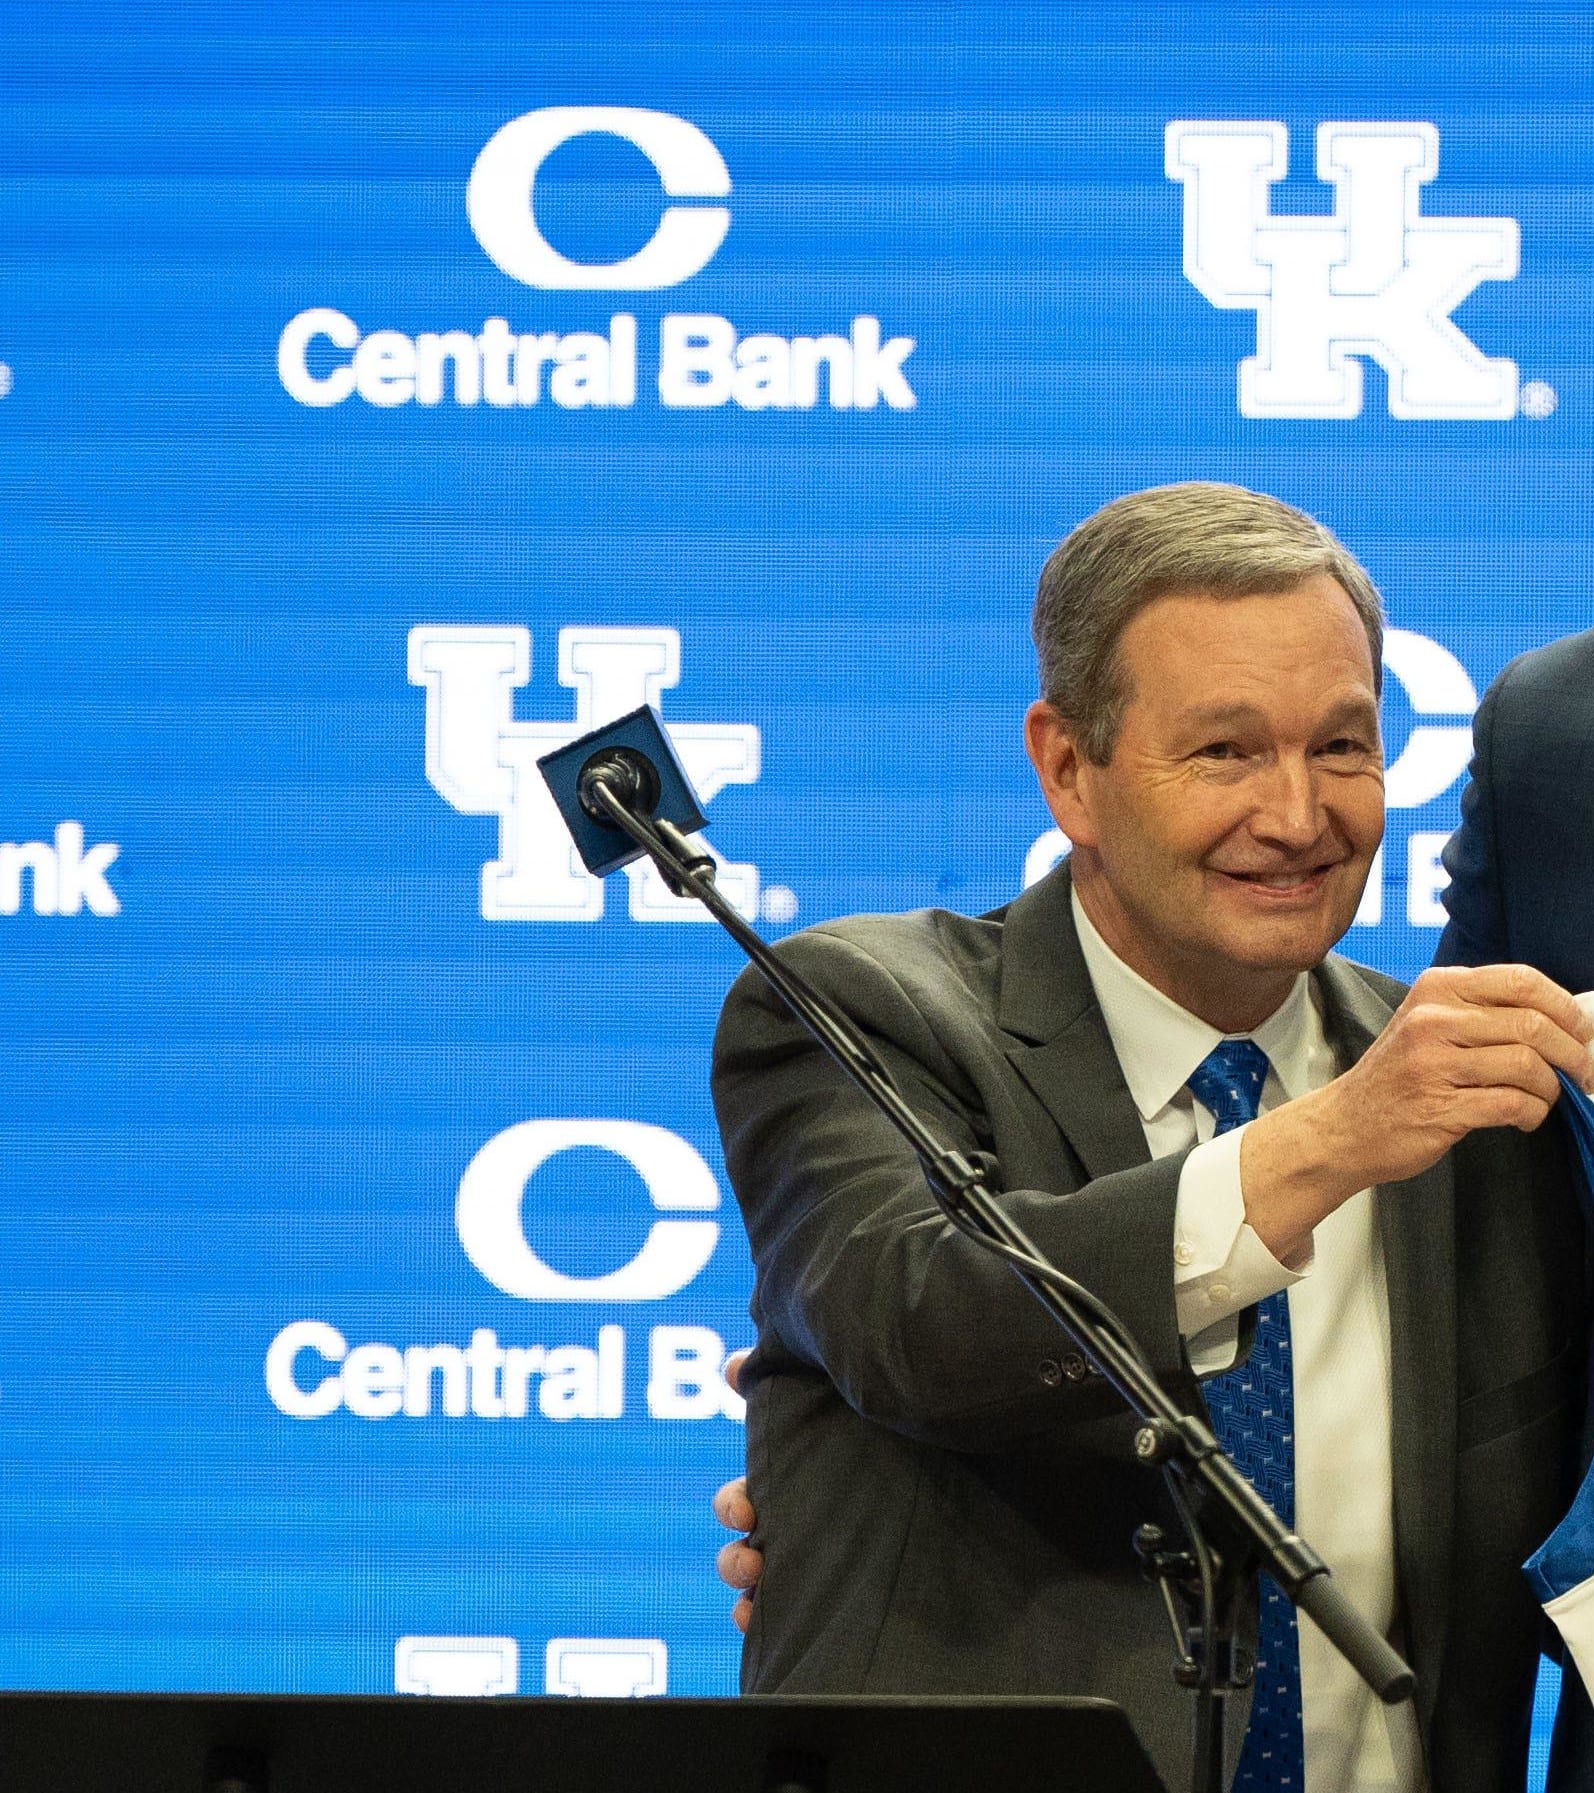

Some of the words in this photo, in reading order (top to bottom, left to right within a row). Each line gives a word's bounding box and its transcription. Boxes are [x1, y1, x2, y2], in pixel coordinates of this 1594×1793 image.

[278, 308, 637, 409] Central
[658, 313, 917, 411] Bank
[265, 1320, 626, 1420] Central
